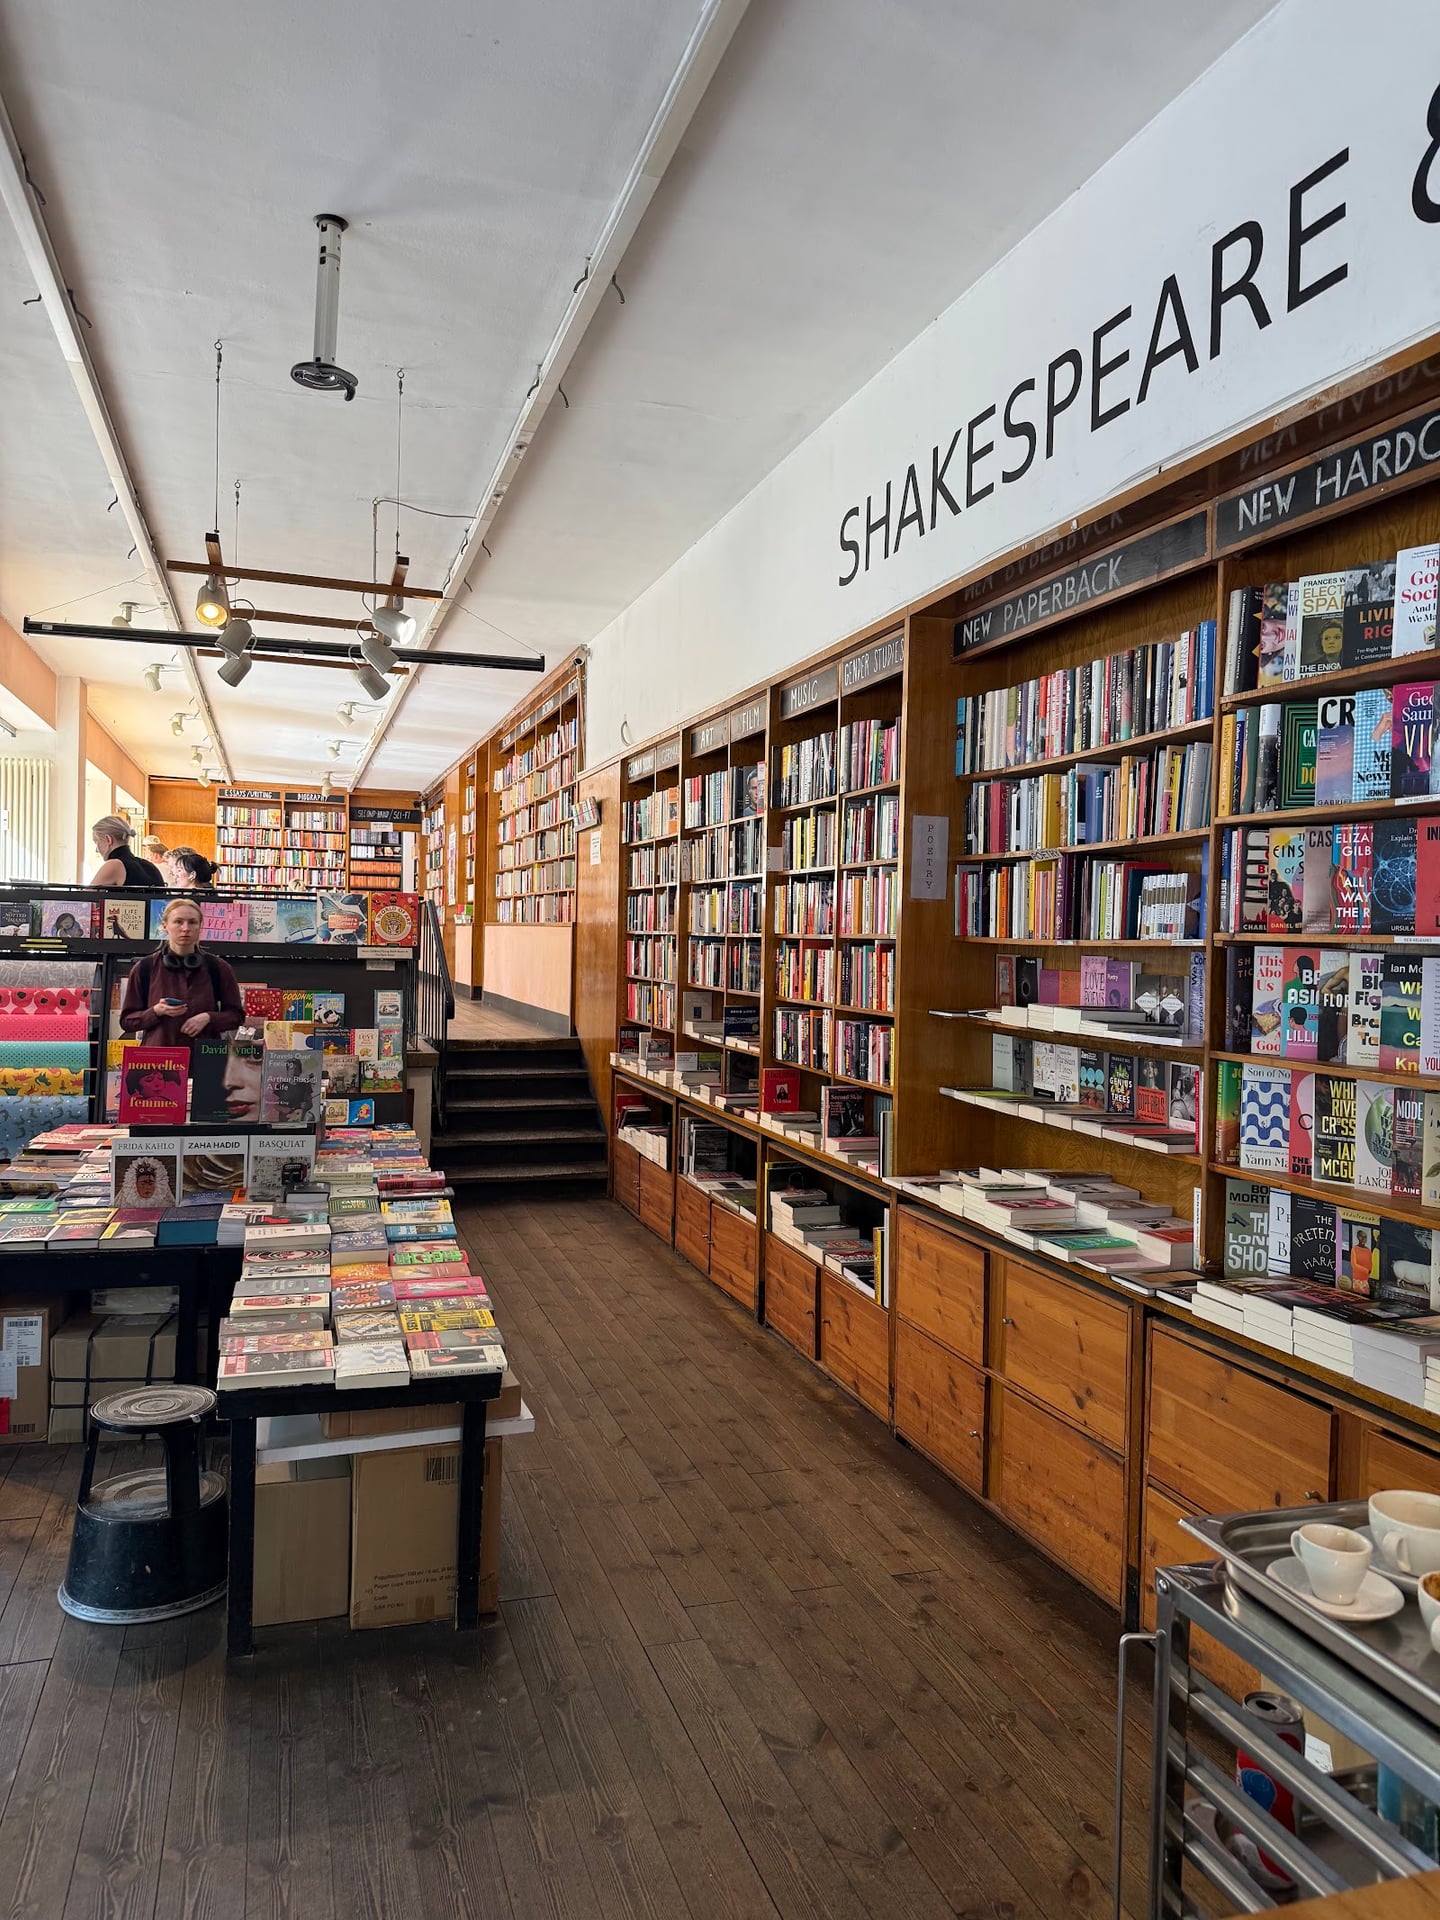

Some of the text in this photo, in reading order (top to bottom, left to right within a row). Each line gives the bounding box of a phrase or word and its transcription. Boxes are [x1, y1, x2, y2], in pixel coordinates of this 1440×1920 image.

[838, 147, 1350, 586] SHAKESPEARE
[1238, 475, 1296, 532] NEW
[1303, 578, 1337, 588] FRANCES
[962, 555, 1124, 648] NEW PAPERBACK
[844, 637, 904, 687] GENDER STUDIES
[790, 680, 818, 707] MUSIC
[741, 707, 760, 729] FILM
[700, 726, 714, 749] ART
[224, 789, 273, 799] ESSAYS/WRITING
[1390, 834, 1413, 843] Explain
[926, 823, 935, 890] POETRY
[1031, 848, 1063, 861] POETRY
[1285, 866, 1295, 874] of
[1343, 877, 1365, 888] ALL
[1340, 892, 1371, 903] WAY
[1336, 907, 1358, 918] THE
[127, 923, 140, 931] ME
[207, 920, 235, 929] VERY
[206, 929, 234, 939] BUSY
[1391, 964, 1406, 973] Ian
[1084, 972, 1105, 990] LOVE
[1256, 980, 1275, 992] Us
[201, 1044, 227, 1055] David
[128, 1061, 186, 1071] nouvelles
[1247, 1063, 1264, 1076] Son
[1266, 1065, 1276, 1076] of
[275, 1083, 289, 1091] Life
[1110, 1077, 1132, 1088] GENIUS
[129, 1097, 178, 1108] femmes
[1112, 1093, 1130, 1104] TREES
[144, 1142, 175, 1150] KAHLO
[213, 1141, 240, 1149] HADID
[259, 1140, 306, 1148] BASQUIAT
[1245, 1154, 1271, 1167] Yann
[1292, 1156, 1309, 1164] THE
[1395, 1185, 1420, 1195] ELAINE
[1315, 1215, 1332, 1226] THE
[1319, 1244, 1331, 1254] JO
[336, 1281, 389, 1291] Irvine
[336, 1300, 391, 1310] Welsh
